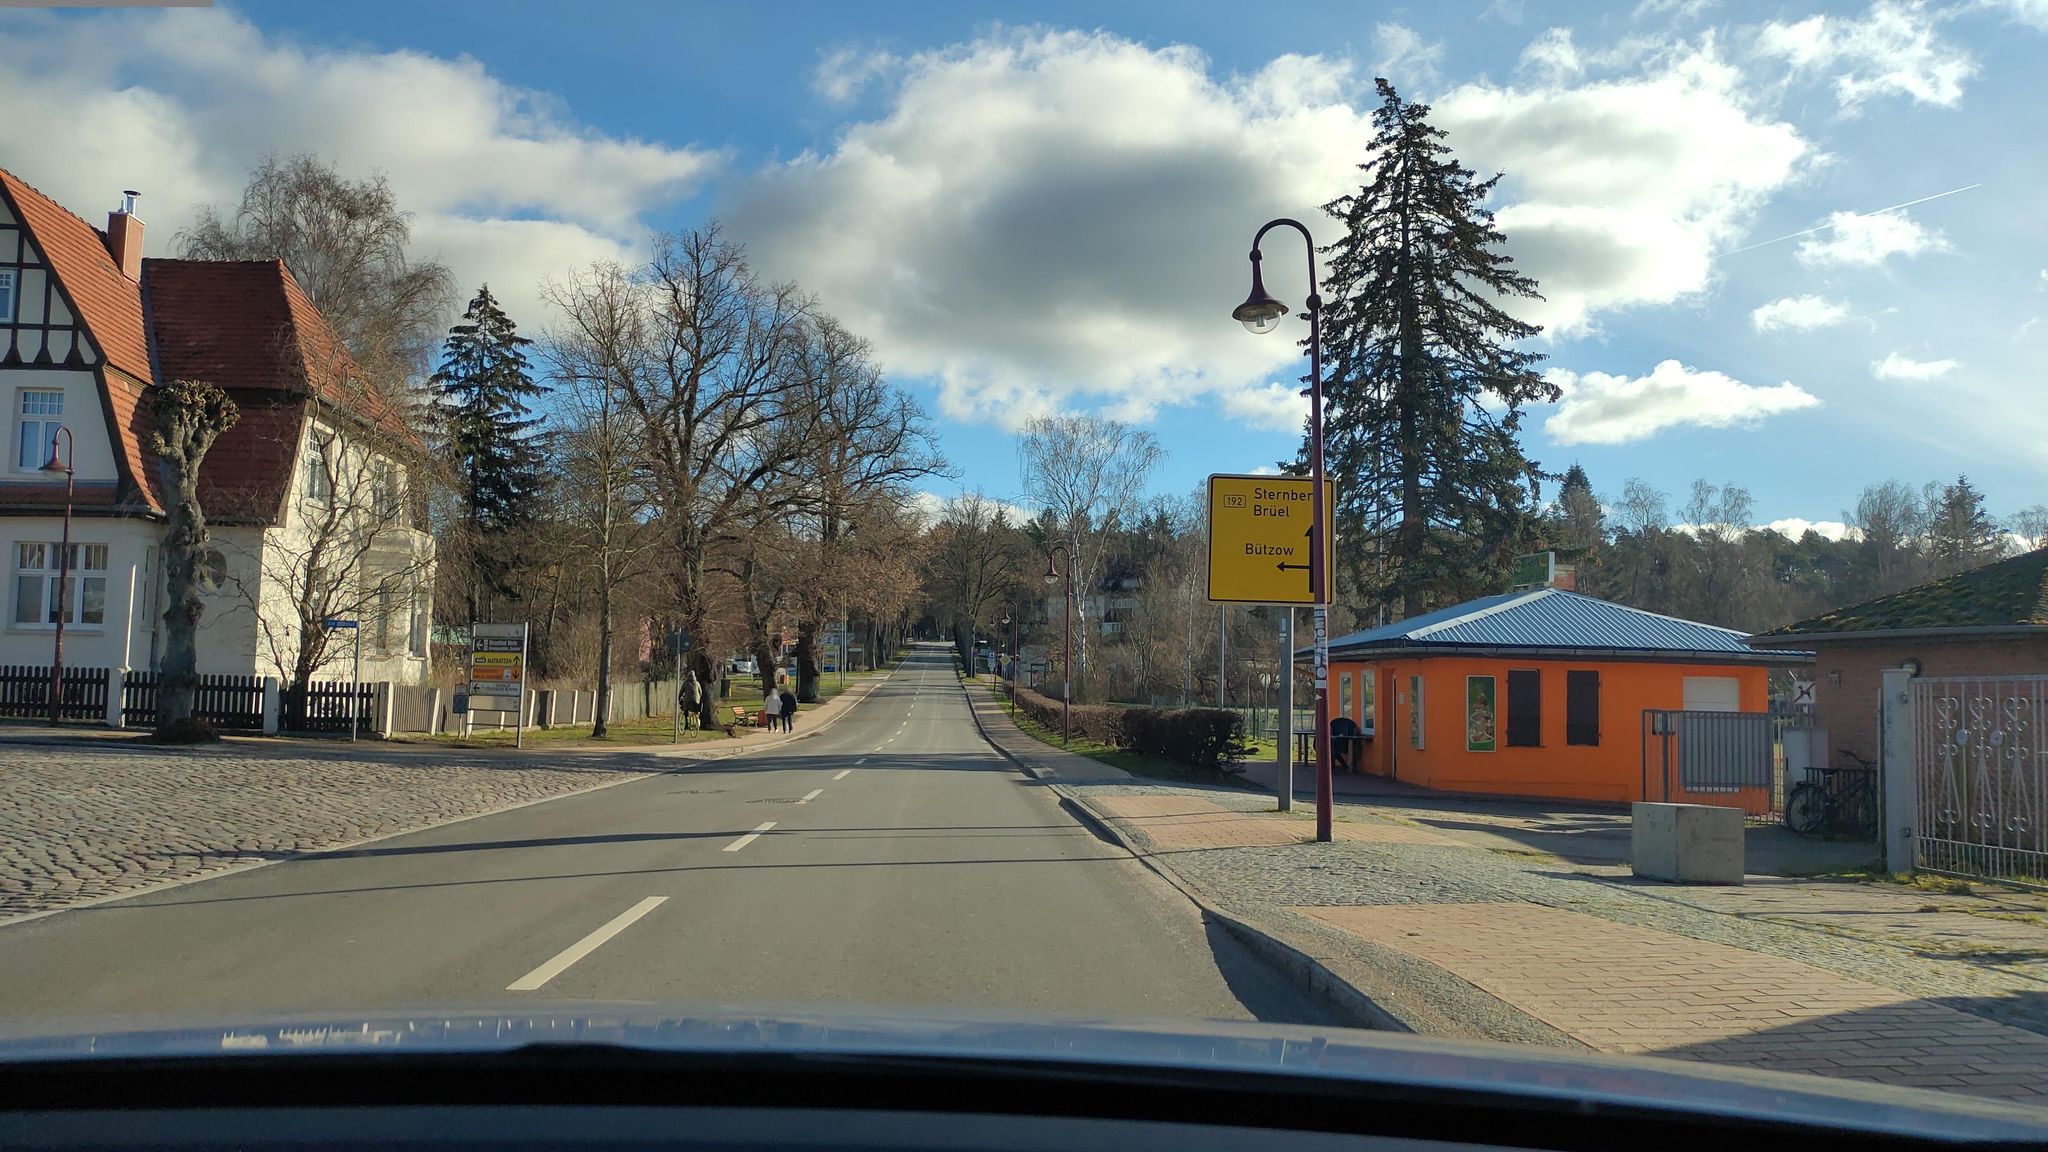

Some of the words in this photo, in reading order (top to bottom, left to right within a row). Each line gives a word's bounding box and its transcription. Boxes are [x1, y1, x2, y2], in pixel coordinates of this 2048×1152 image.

[1254, 488, 1314, 501] Sternber
[1227, 497, 1243, 506] 192
[1254, 505, 1290, 517] Brüel
[1245, 543, 1294, 556] Bützow
